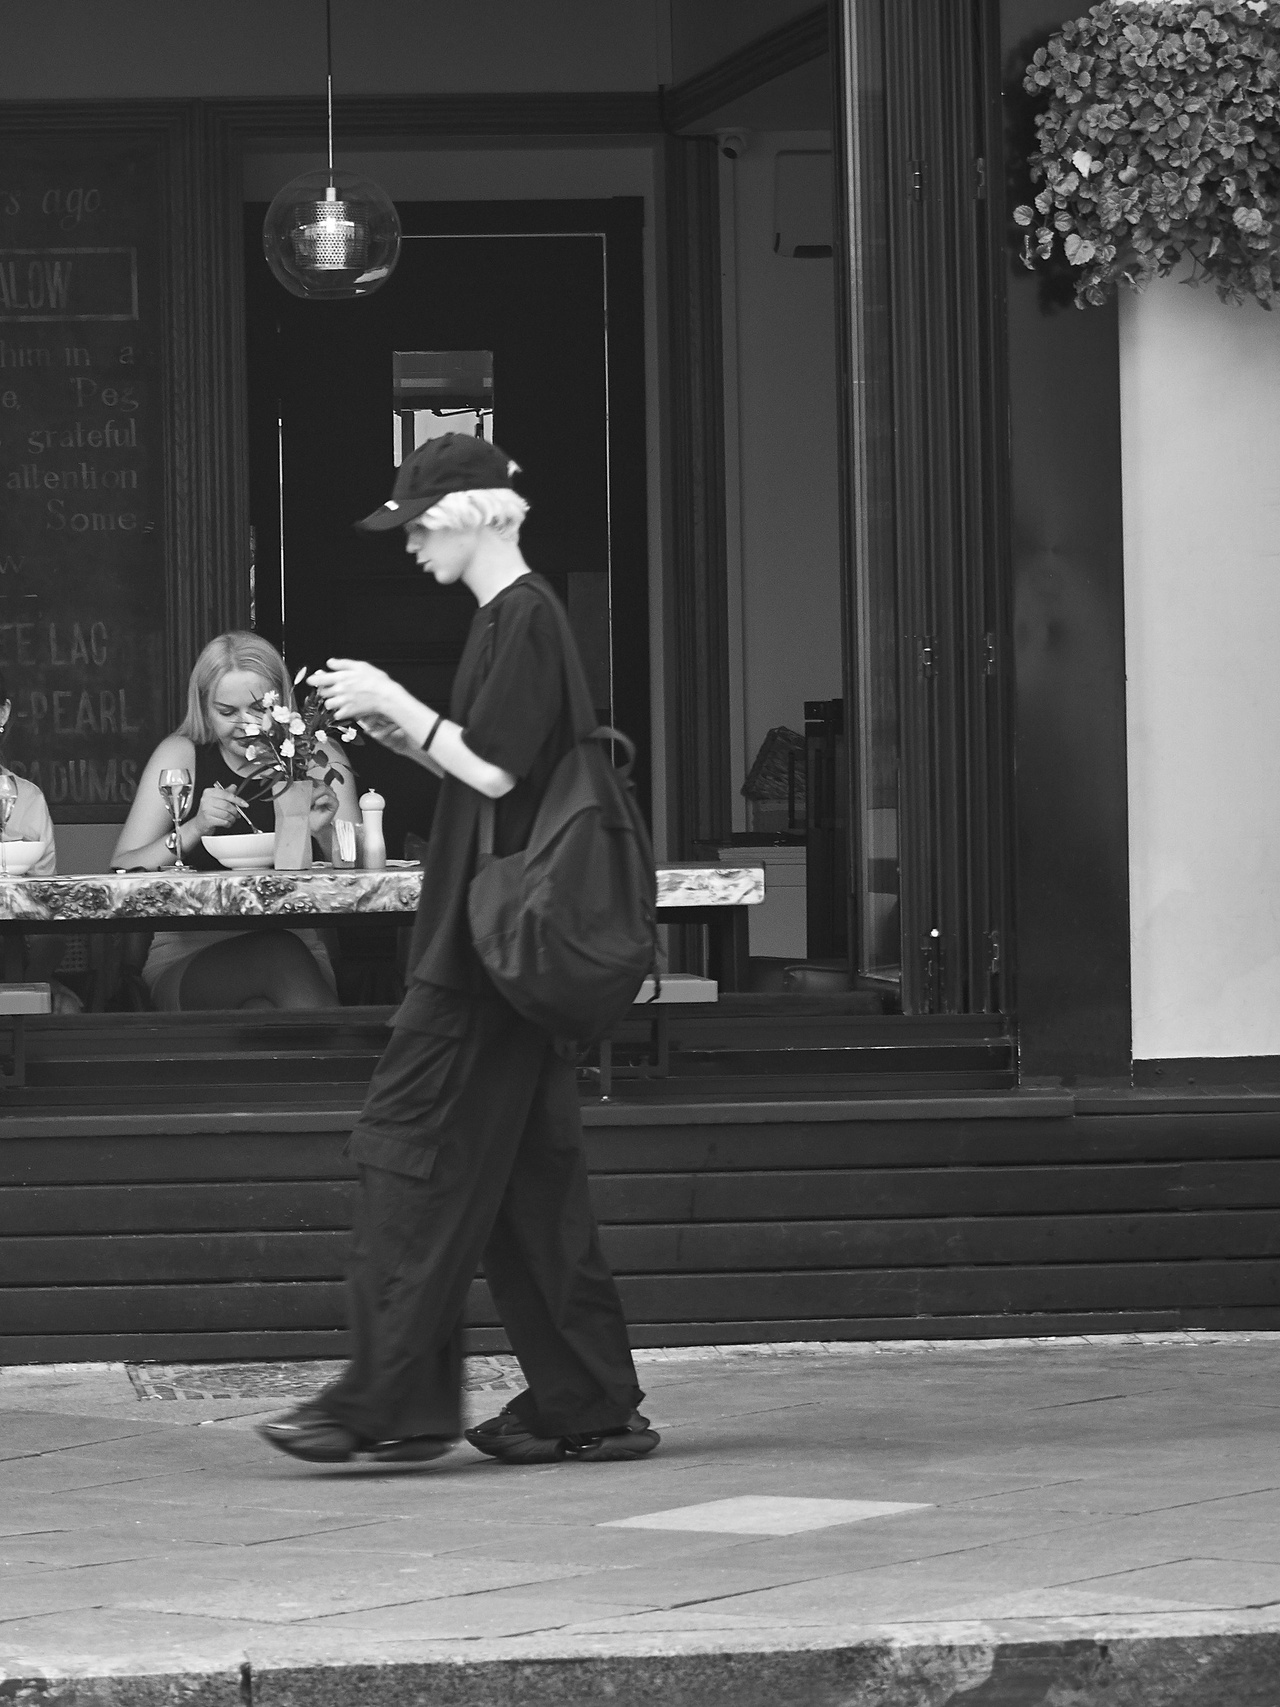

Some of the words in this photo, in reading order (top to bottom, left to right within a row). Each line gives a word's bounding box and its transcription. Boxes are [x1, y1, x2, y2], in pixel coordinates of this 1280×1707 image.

[0, 339, 51, 368] him
[65, 346, 91, 366] in
[119, 345, 136, 365] a
[27, 417, 139, 455] grateful
[5, 461, 138, 490] attention
[45, 498, 138, 531] Some
[48, 620, 109, 667] LAC
